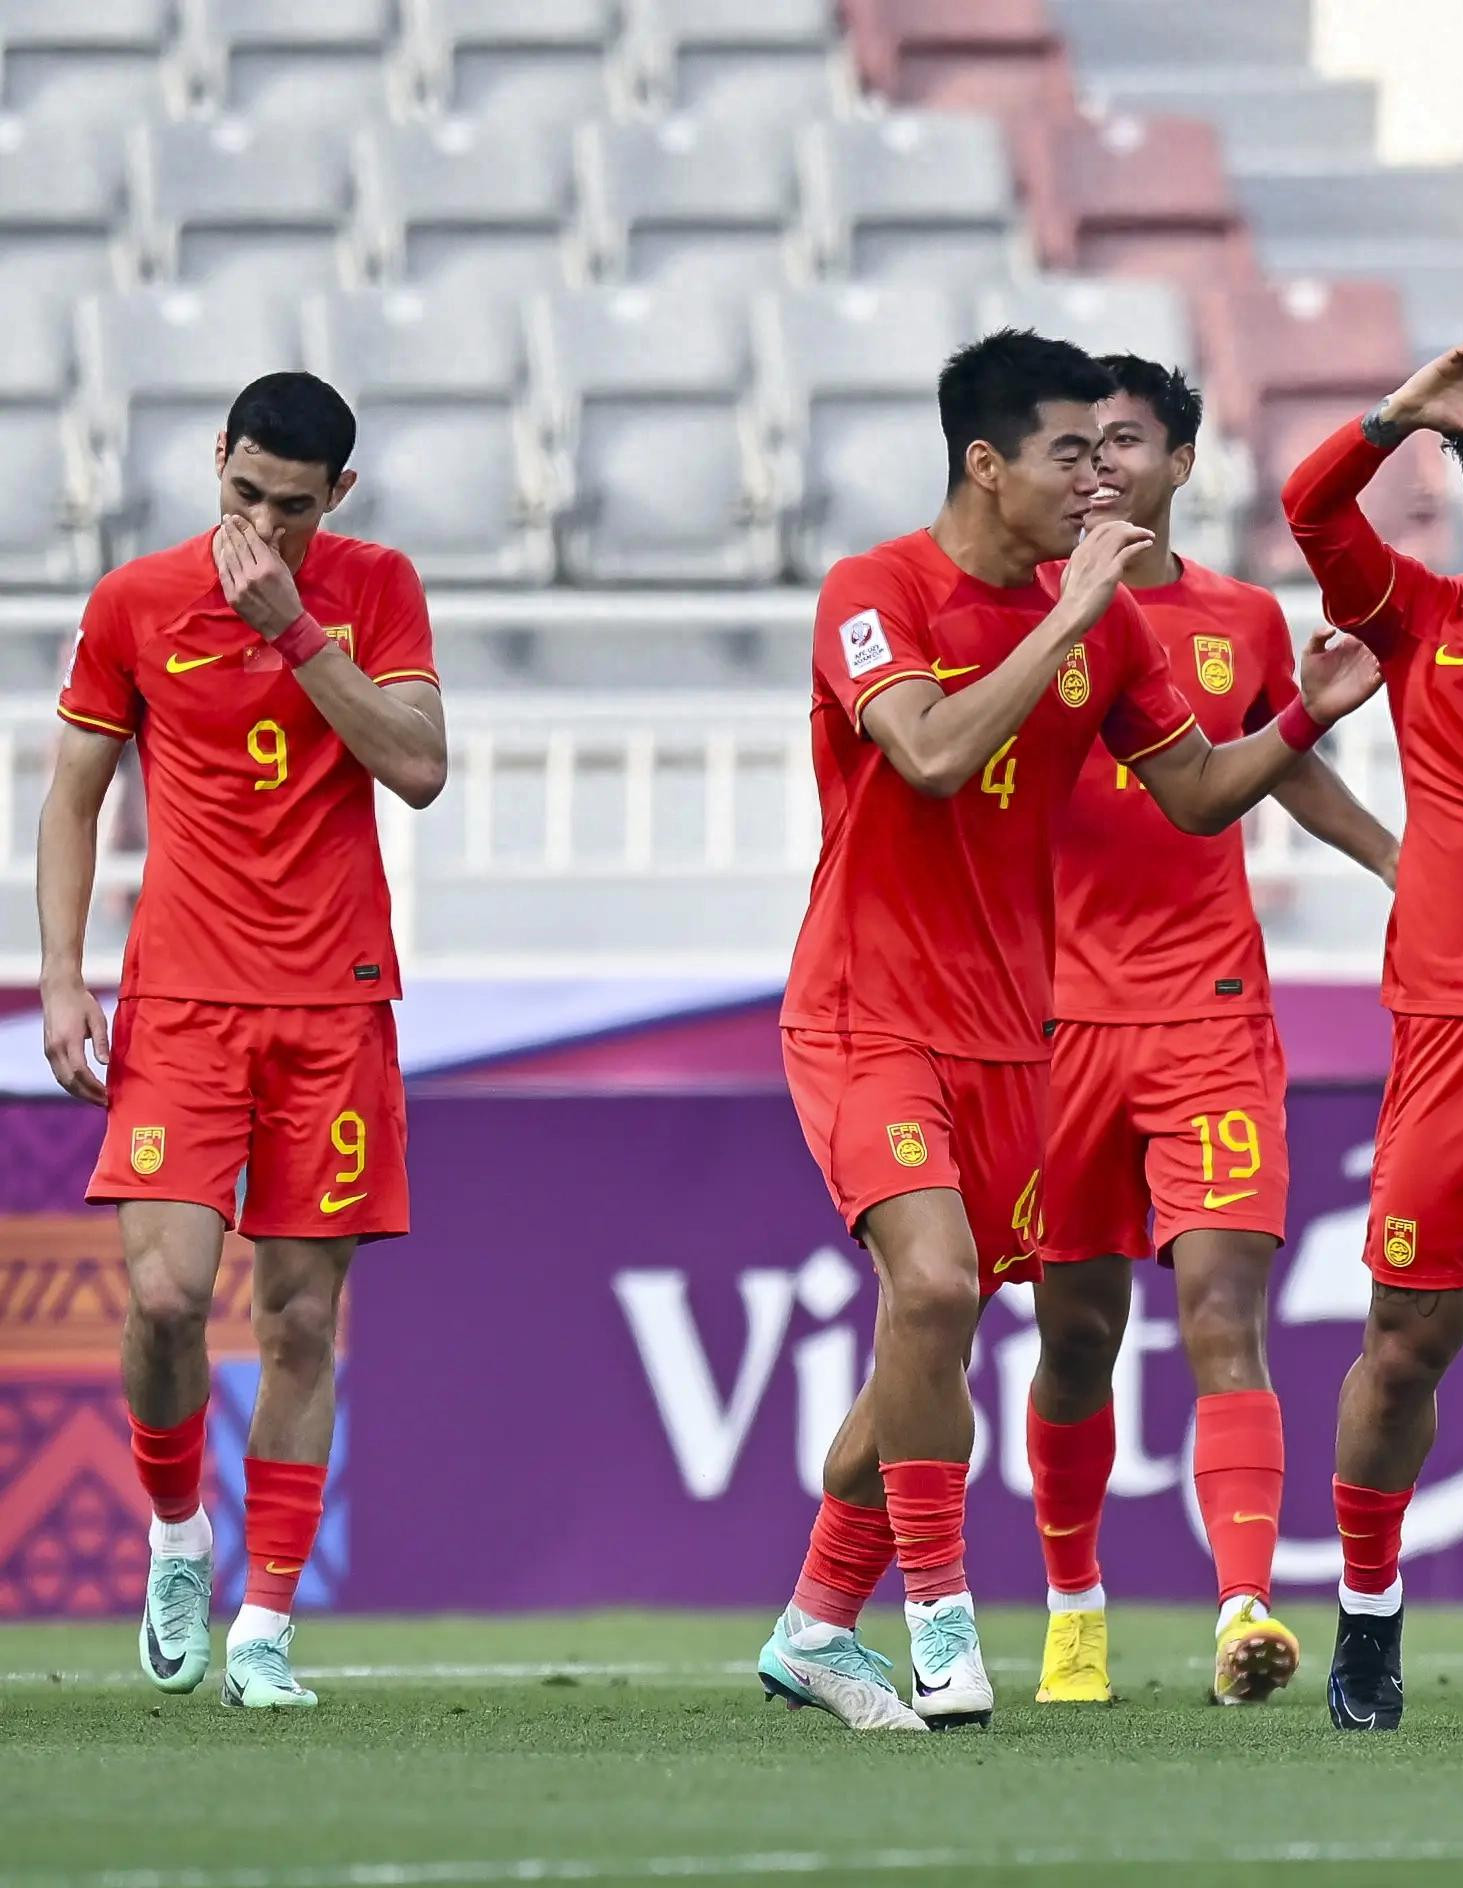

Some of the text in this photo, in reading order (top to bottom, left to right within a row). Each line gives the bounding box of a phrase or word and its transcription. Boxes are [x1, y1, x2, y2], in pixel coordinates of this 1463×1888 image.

[325, 630, 348, 640] FA
[1198, 640, 1229, 653] CFA
[247, 719, 289, 792] 9
[981, 734, 1018, 810] 4
[135, 1131, 162, 1140] CFA
[330, 1110, 367, 1185] 9
[891, 1125, 919, 1136] CFA
[1191, 1109, 1262, 1182] 19
[1011, 1168, 1044, 1241] 4
[1387, 1220, 1413, 1233] CFA
[610, 1244, 1182, 1502] Viit
